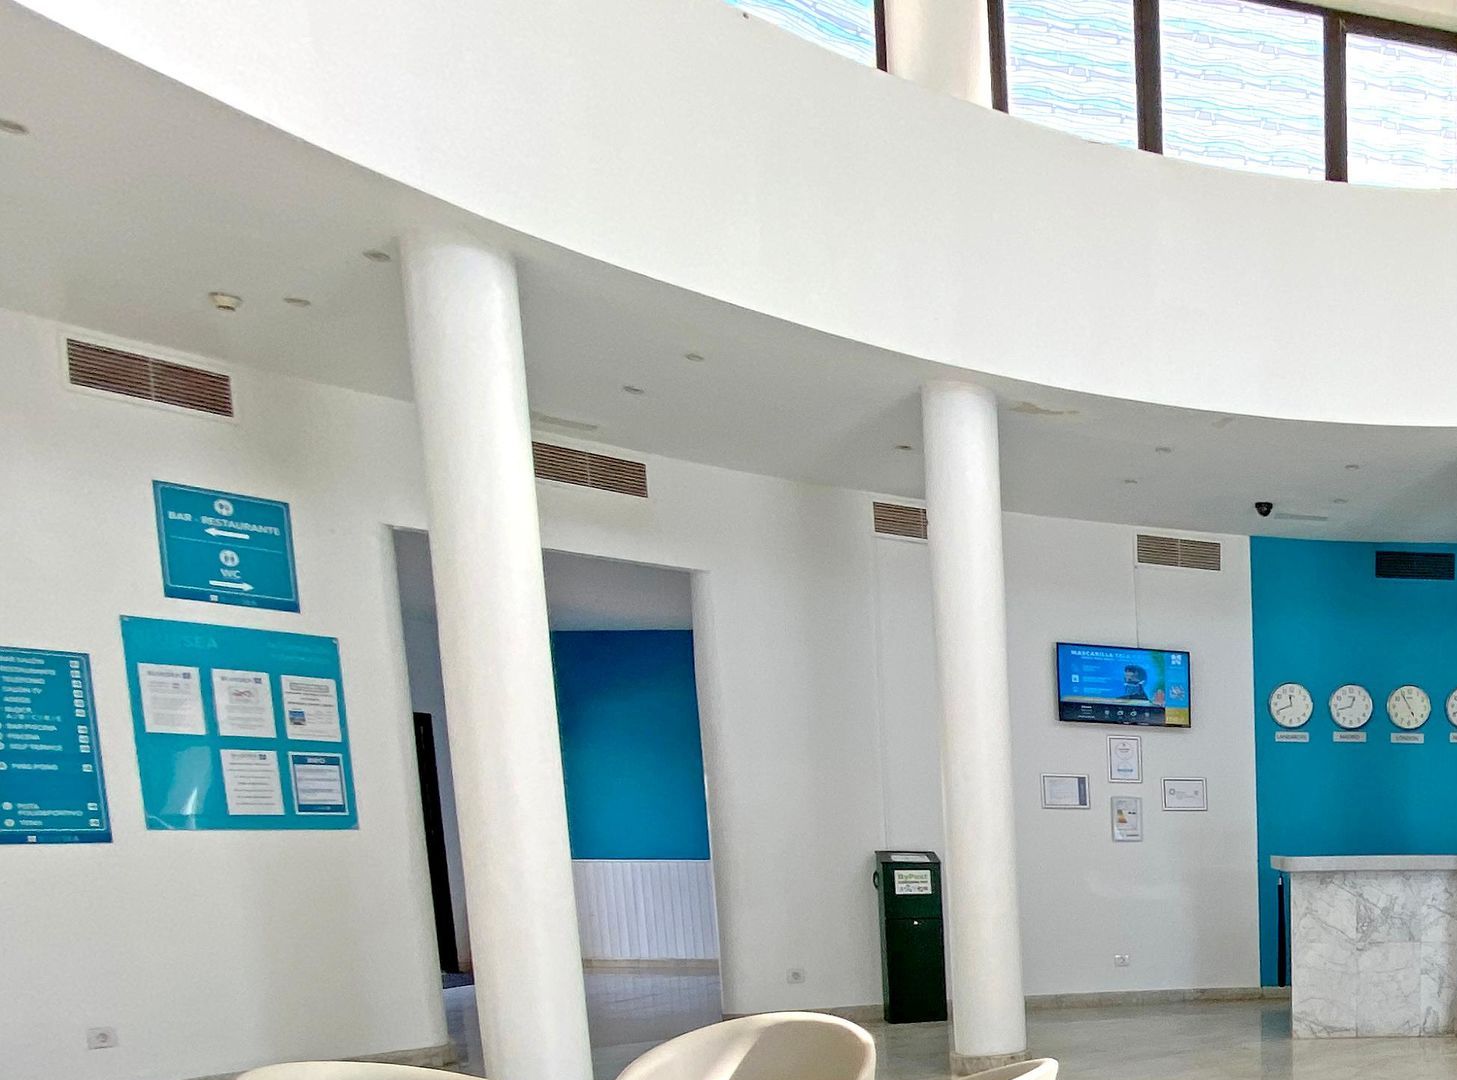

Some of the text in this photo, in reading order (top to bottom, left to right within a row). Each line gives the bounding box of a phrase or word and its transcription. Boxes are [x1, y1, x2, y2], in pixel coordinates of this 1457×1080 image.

[167, 511, 192, 521] BAR
[201, 516, 280, 535] RESTAURANTE
[220, 569, 241, 579] WC
[1071, 650, 1114, 658] MASCARILLA
